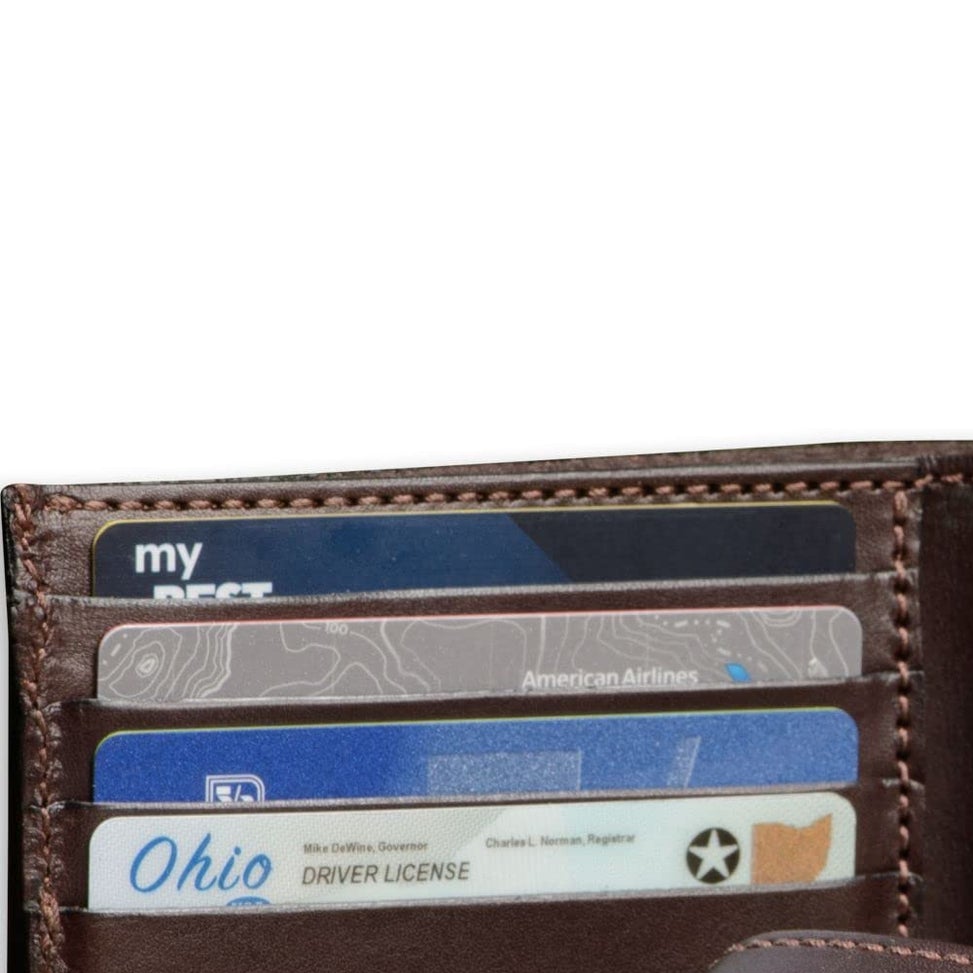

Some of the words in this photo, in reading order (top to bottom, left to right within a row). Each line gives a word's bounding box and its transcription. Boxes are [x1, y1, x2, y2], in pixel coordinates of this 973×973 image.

[135, 542, 203, 580] my
[522, 668, 619, 688] American
[622, 667, 699, 685] Airlines
[303, 843, 329, 854] Mike
[378, 841, 428, 852] Governor
[485, 837, 526, 848] Charles
[587, 833, 636, 846] Registrar
[130, 832, 273, 893] Ohio
[302, 864, 379, 885] DRIVER
[384, 862, 471, 883] LICENSE
